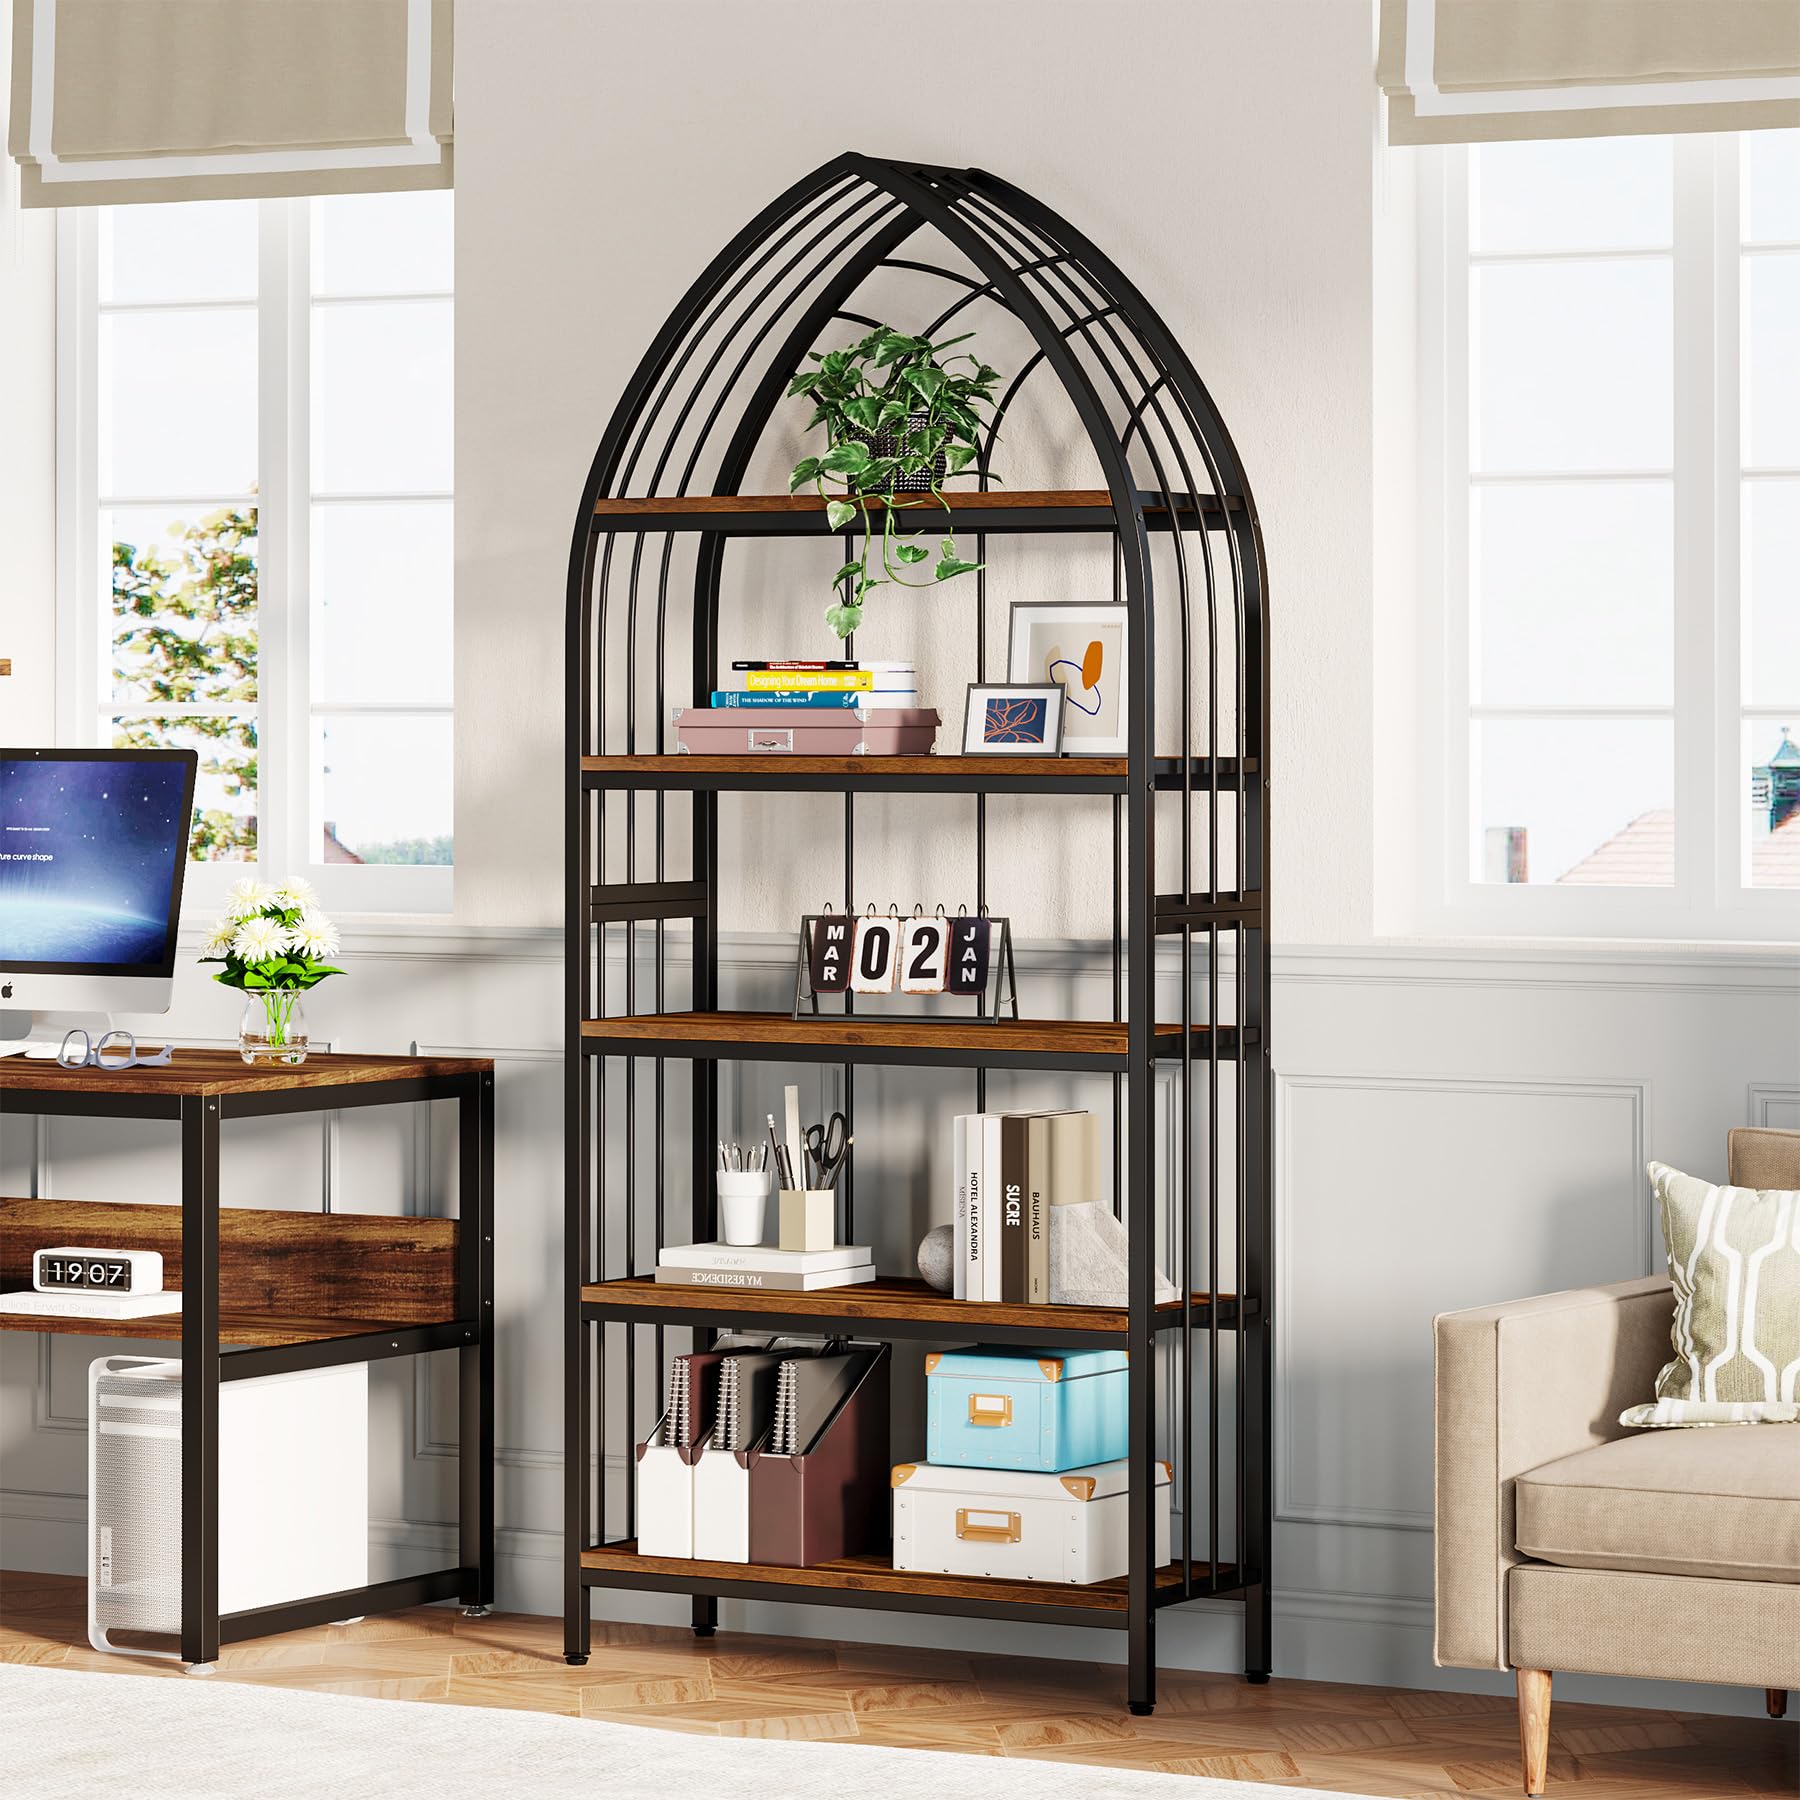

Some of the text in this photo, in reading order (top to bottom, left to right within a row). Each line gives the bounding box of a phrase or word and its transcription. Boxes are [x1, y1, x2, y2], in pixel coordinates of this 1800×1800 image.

[750, 674, 781, 688] Designing
[782, 674, 796, 686] Your
[796, 674, 818, 686] Dream
[818, 674, 837, 686] Home
[12, 853, 32, 861] curve
[32, 852, 54, 863] shape
[823, 925, 844, 981] MAR
[961, 926, 977, 983] JAN
[970, 1172, 978, 1262] HOTEL ALEXANDRA
[1006, 1184, 1020, 1227] SUCRE
[1032, 1191, 1040, 1240] BAUHAUS
